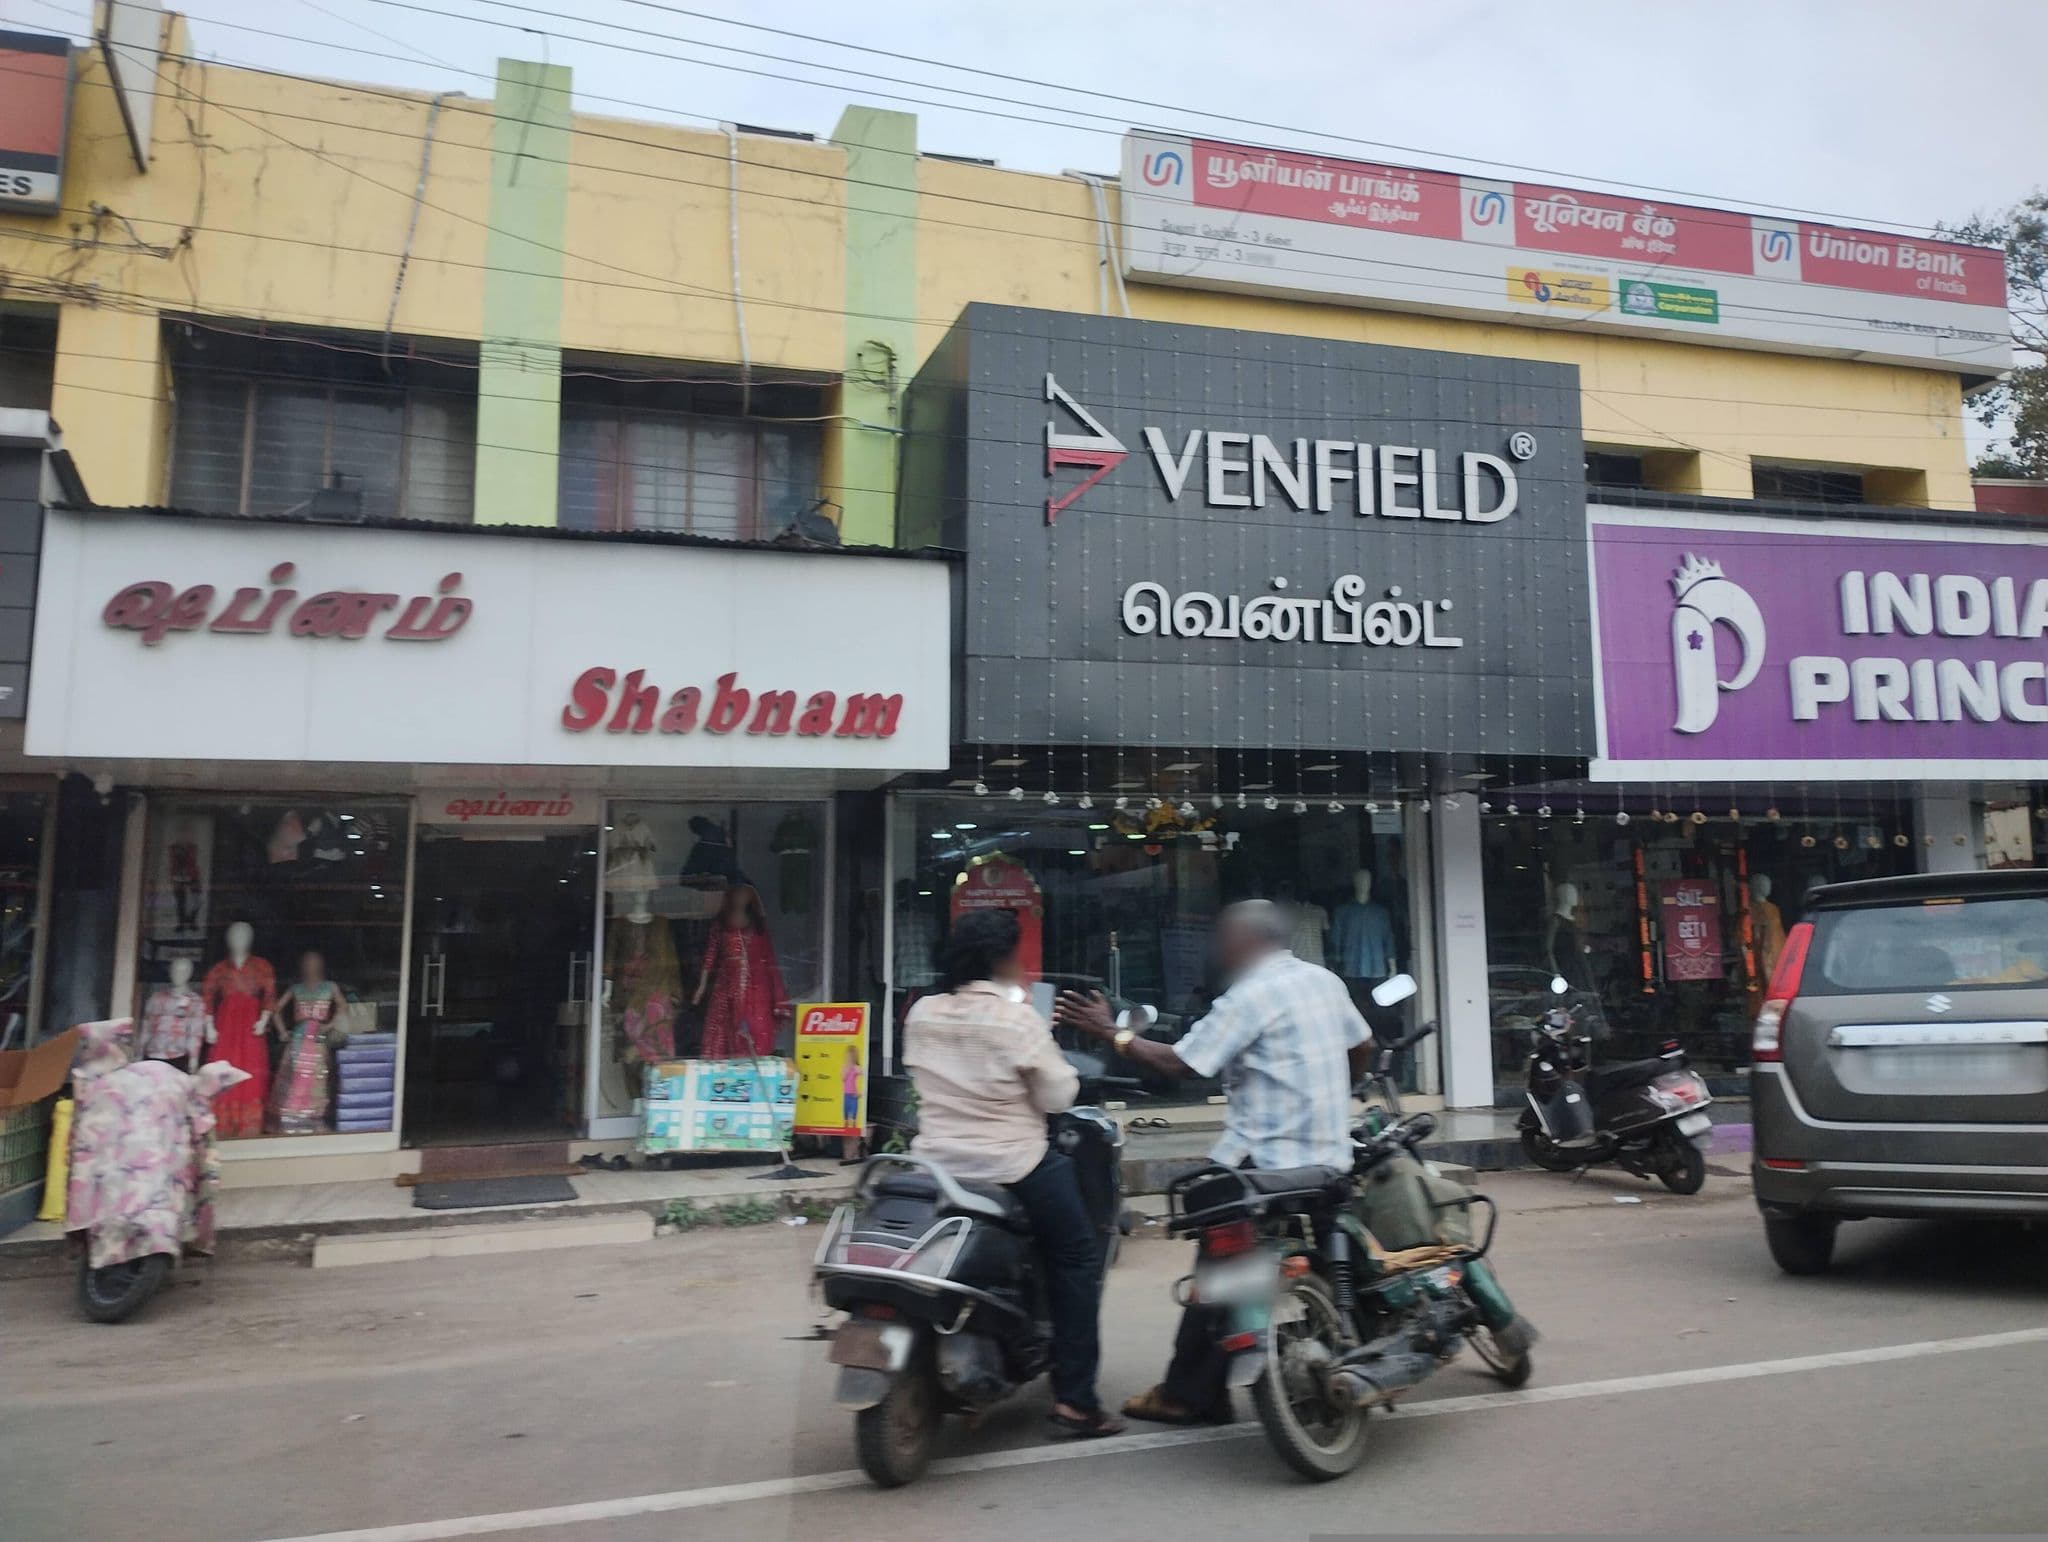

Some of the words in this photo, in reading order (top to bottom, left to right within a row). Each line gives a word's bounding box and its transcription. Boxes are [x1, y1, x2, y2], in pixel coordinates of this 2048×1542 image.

[1207, 154, 1334, 192] யூனியன்
[1339, 170, 1420, 203] பாங்க்
[1524, 194, 1626, 233] यूनियन
[1809, 231, 1889, 267] Union
[1896, 244, 1966, 277] Bank
[1917, 276, 1932, 290] of
[1934, 278, 1968, 296] India
[1144, 427, 1519, 524] VENFIELD
[103, 562, 473, 646] ஷப்னம்
[1123, 574, 1463, 648] வென்பீல்ட்
[562, 666, 905, 740] Shabnam
[1790, 655, 2048, 722] PRINC
